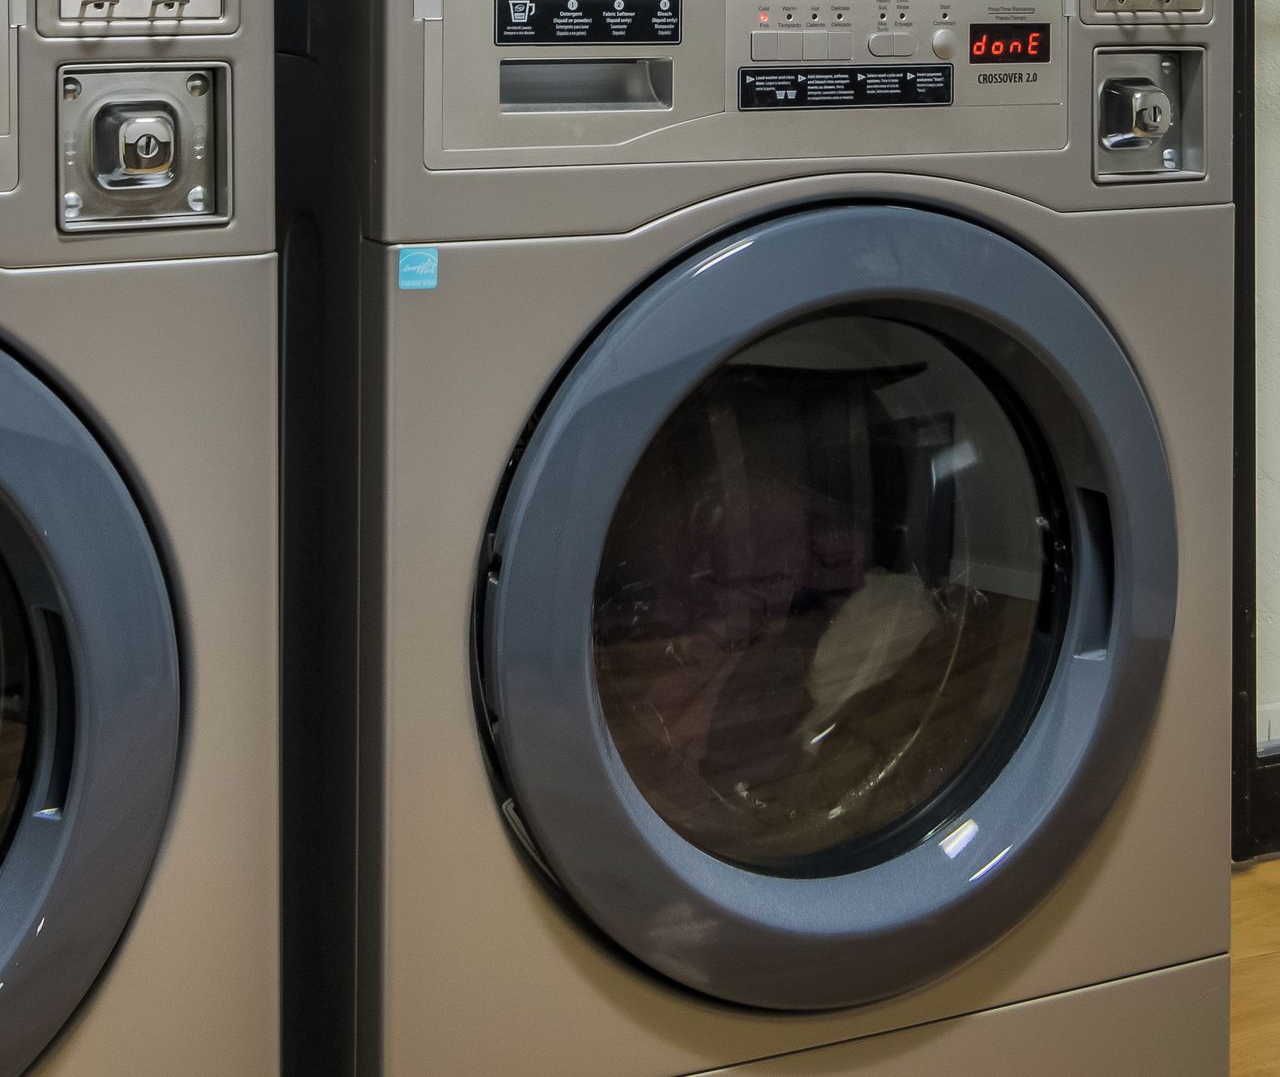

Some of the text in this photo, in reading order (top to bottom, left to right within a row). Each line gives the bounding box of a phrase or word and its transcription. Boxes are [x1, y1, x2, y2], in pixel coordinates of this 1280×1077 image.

[972, 32, 1040, 55] donE
[977, 72, 1038, 84] CROSSOVER 2.0
